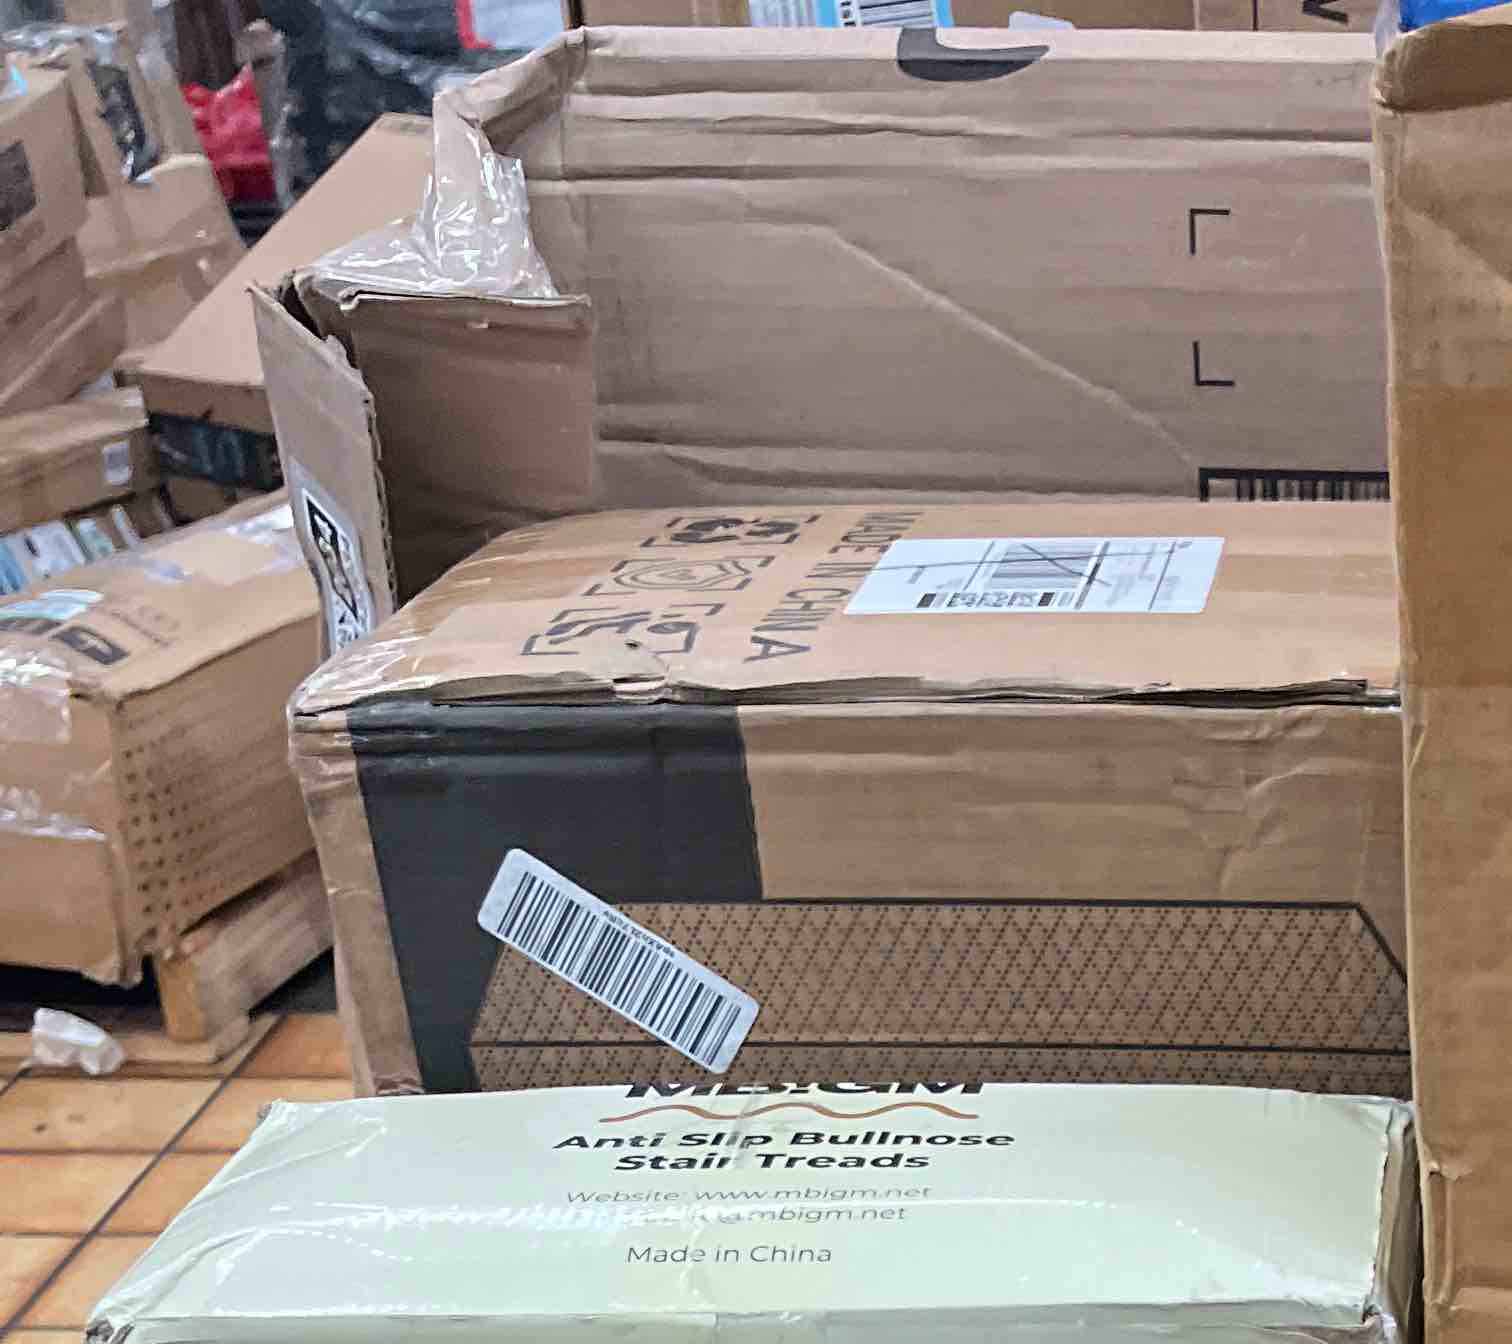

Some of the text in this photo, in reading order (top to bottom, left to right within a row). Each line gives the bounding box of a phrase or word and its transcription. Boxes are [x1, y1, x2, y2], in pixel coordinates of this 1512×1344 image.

[805, 561, 880, 578] IN
[743, 587, 853, 664] CHINA
[553, 1130, 1017, 1152] Anti Slip Bullnose
[614, 1153, 931, 1171] Stair Treads
[696, 1185, 932, 1202] www.mbigm.net
[626, 1244, 832, 1264] Made in China
